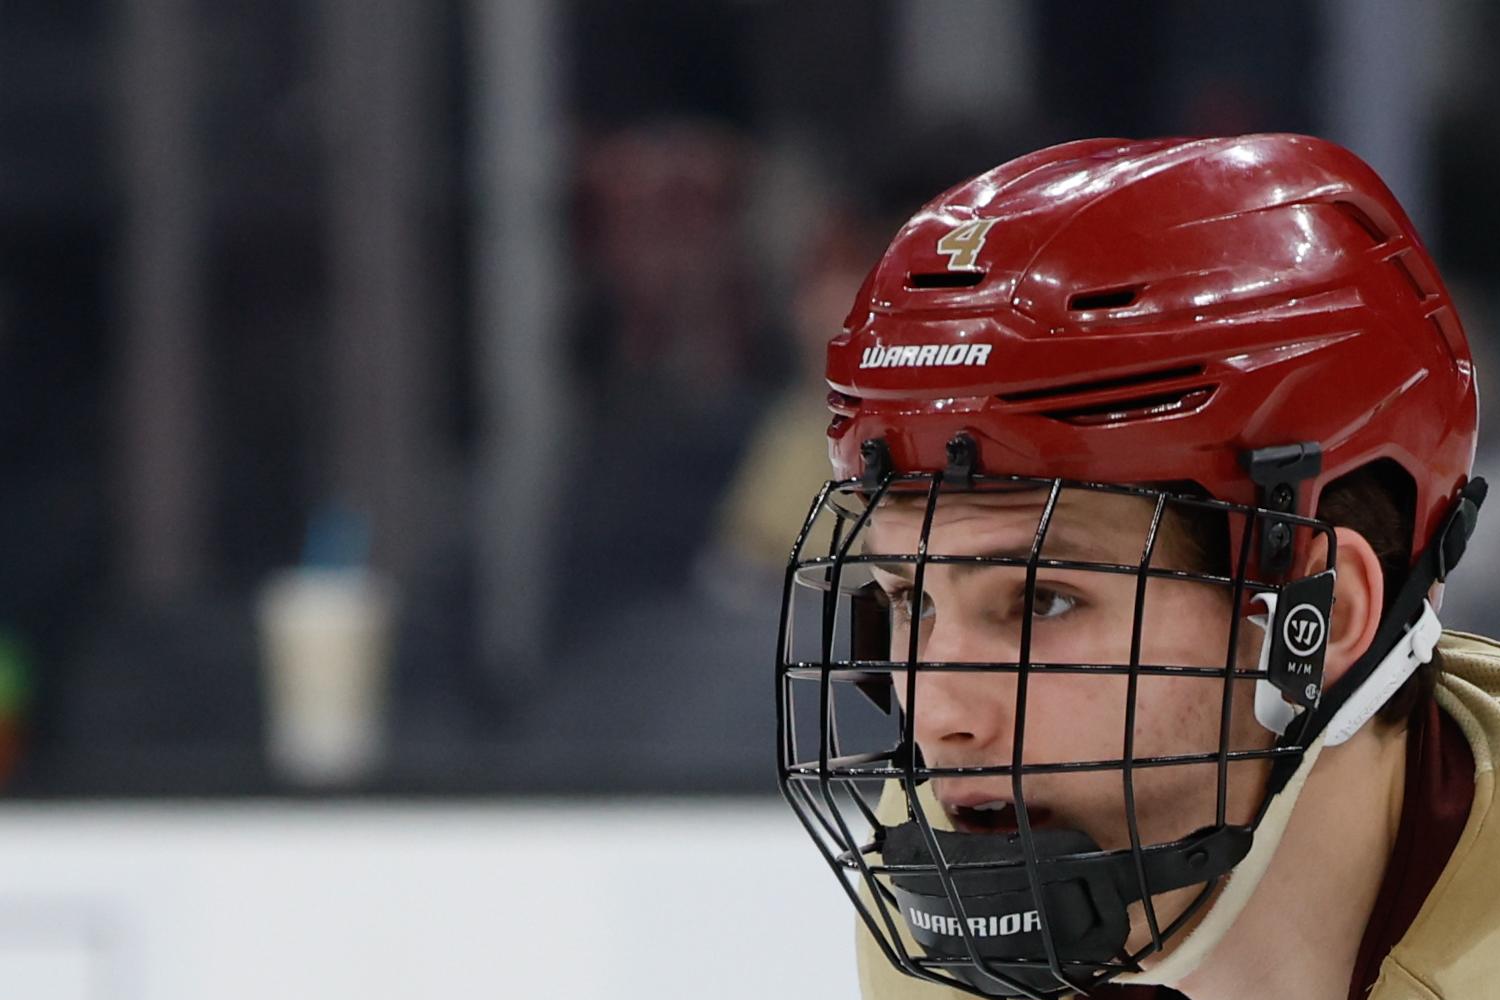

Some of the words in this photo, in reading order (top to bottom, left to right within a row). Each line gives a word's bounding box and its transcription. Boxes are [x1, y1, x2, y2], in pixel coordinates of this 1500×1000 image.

[937, 219, 996, 270] 4
[859, 343, 992, 369] WARRIOR
[909, 907, 1042, 937] WARRIOR
